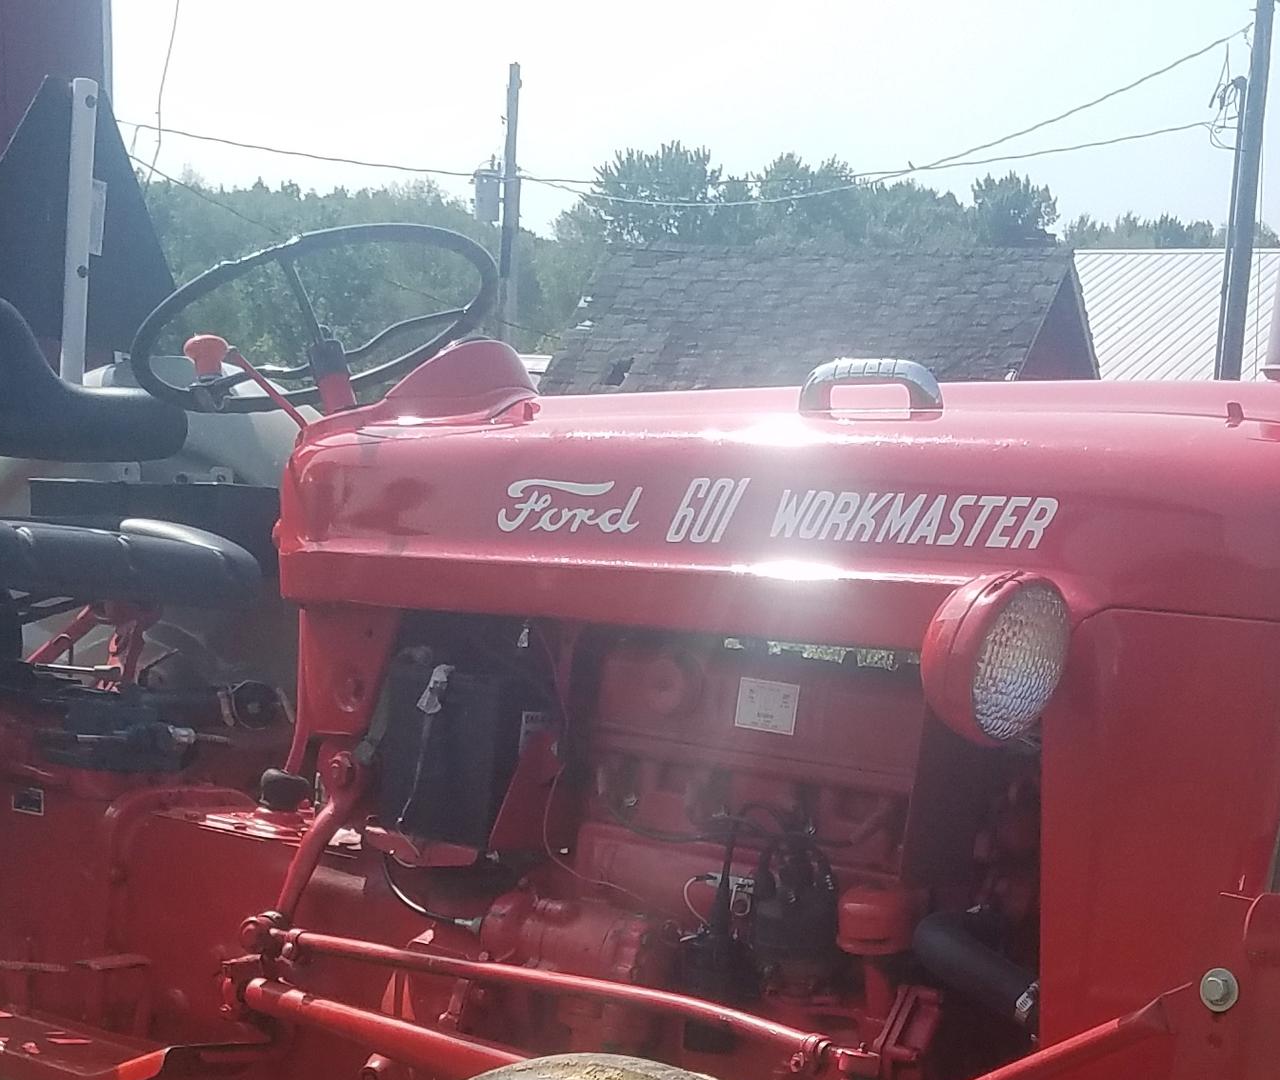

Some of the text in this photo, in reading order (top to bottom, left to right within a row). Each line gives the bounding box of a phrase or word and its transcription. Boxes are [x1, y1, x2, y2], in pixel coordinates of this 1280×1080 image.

[497, 477, 1059, 550] Ford 601 WORKMASTER
